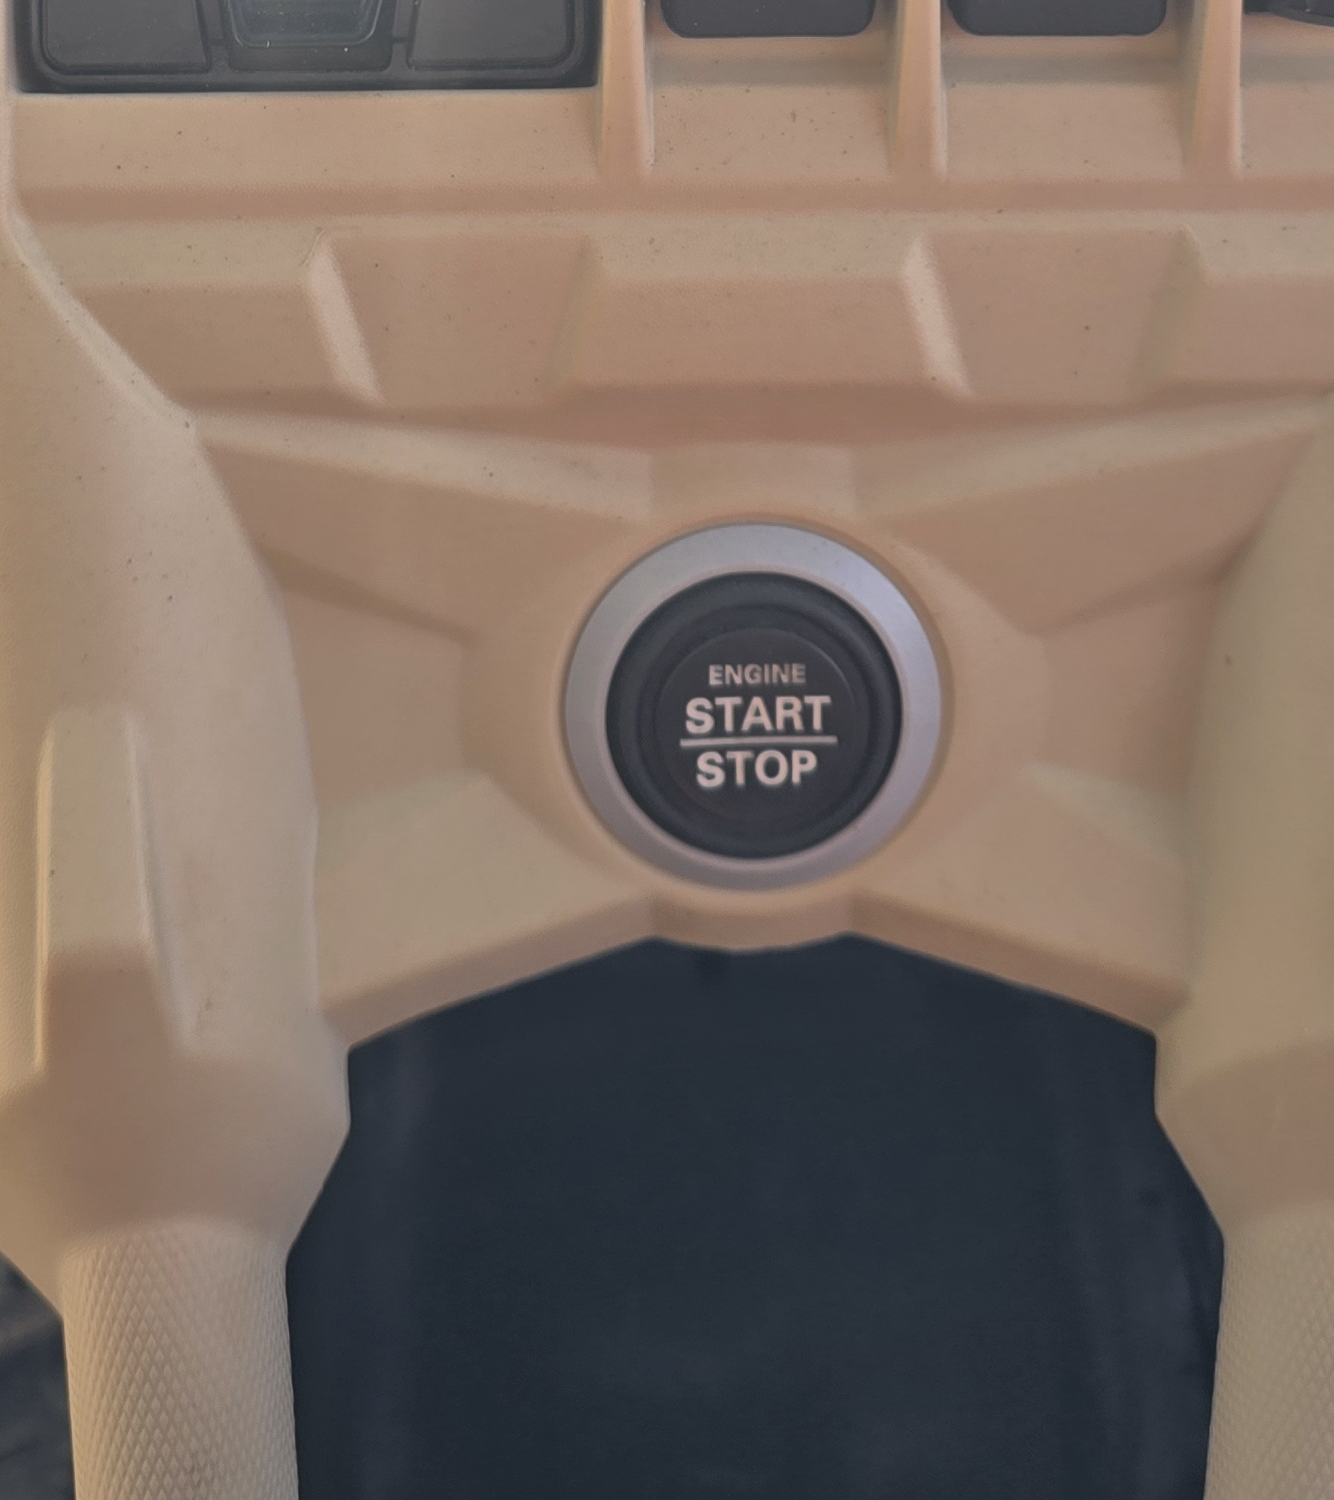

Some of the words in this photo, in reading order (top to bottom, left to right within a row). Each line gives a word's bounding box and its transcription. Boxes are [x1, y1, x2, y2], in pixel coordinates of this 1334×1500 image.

[708, 663, 806, 686] ENGINE
[685, 695, 831, 734] START
[696, 750, 818, 789] STOP
